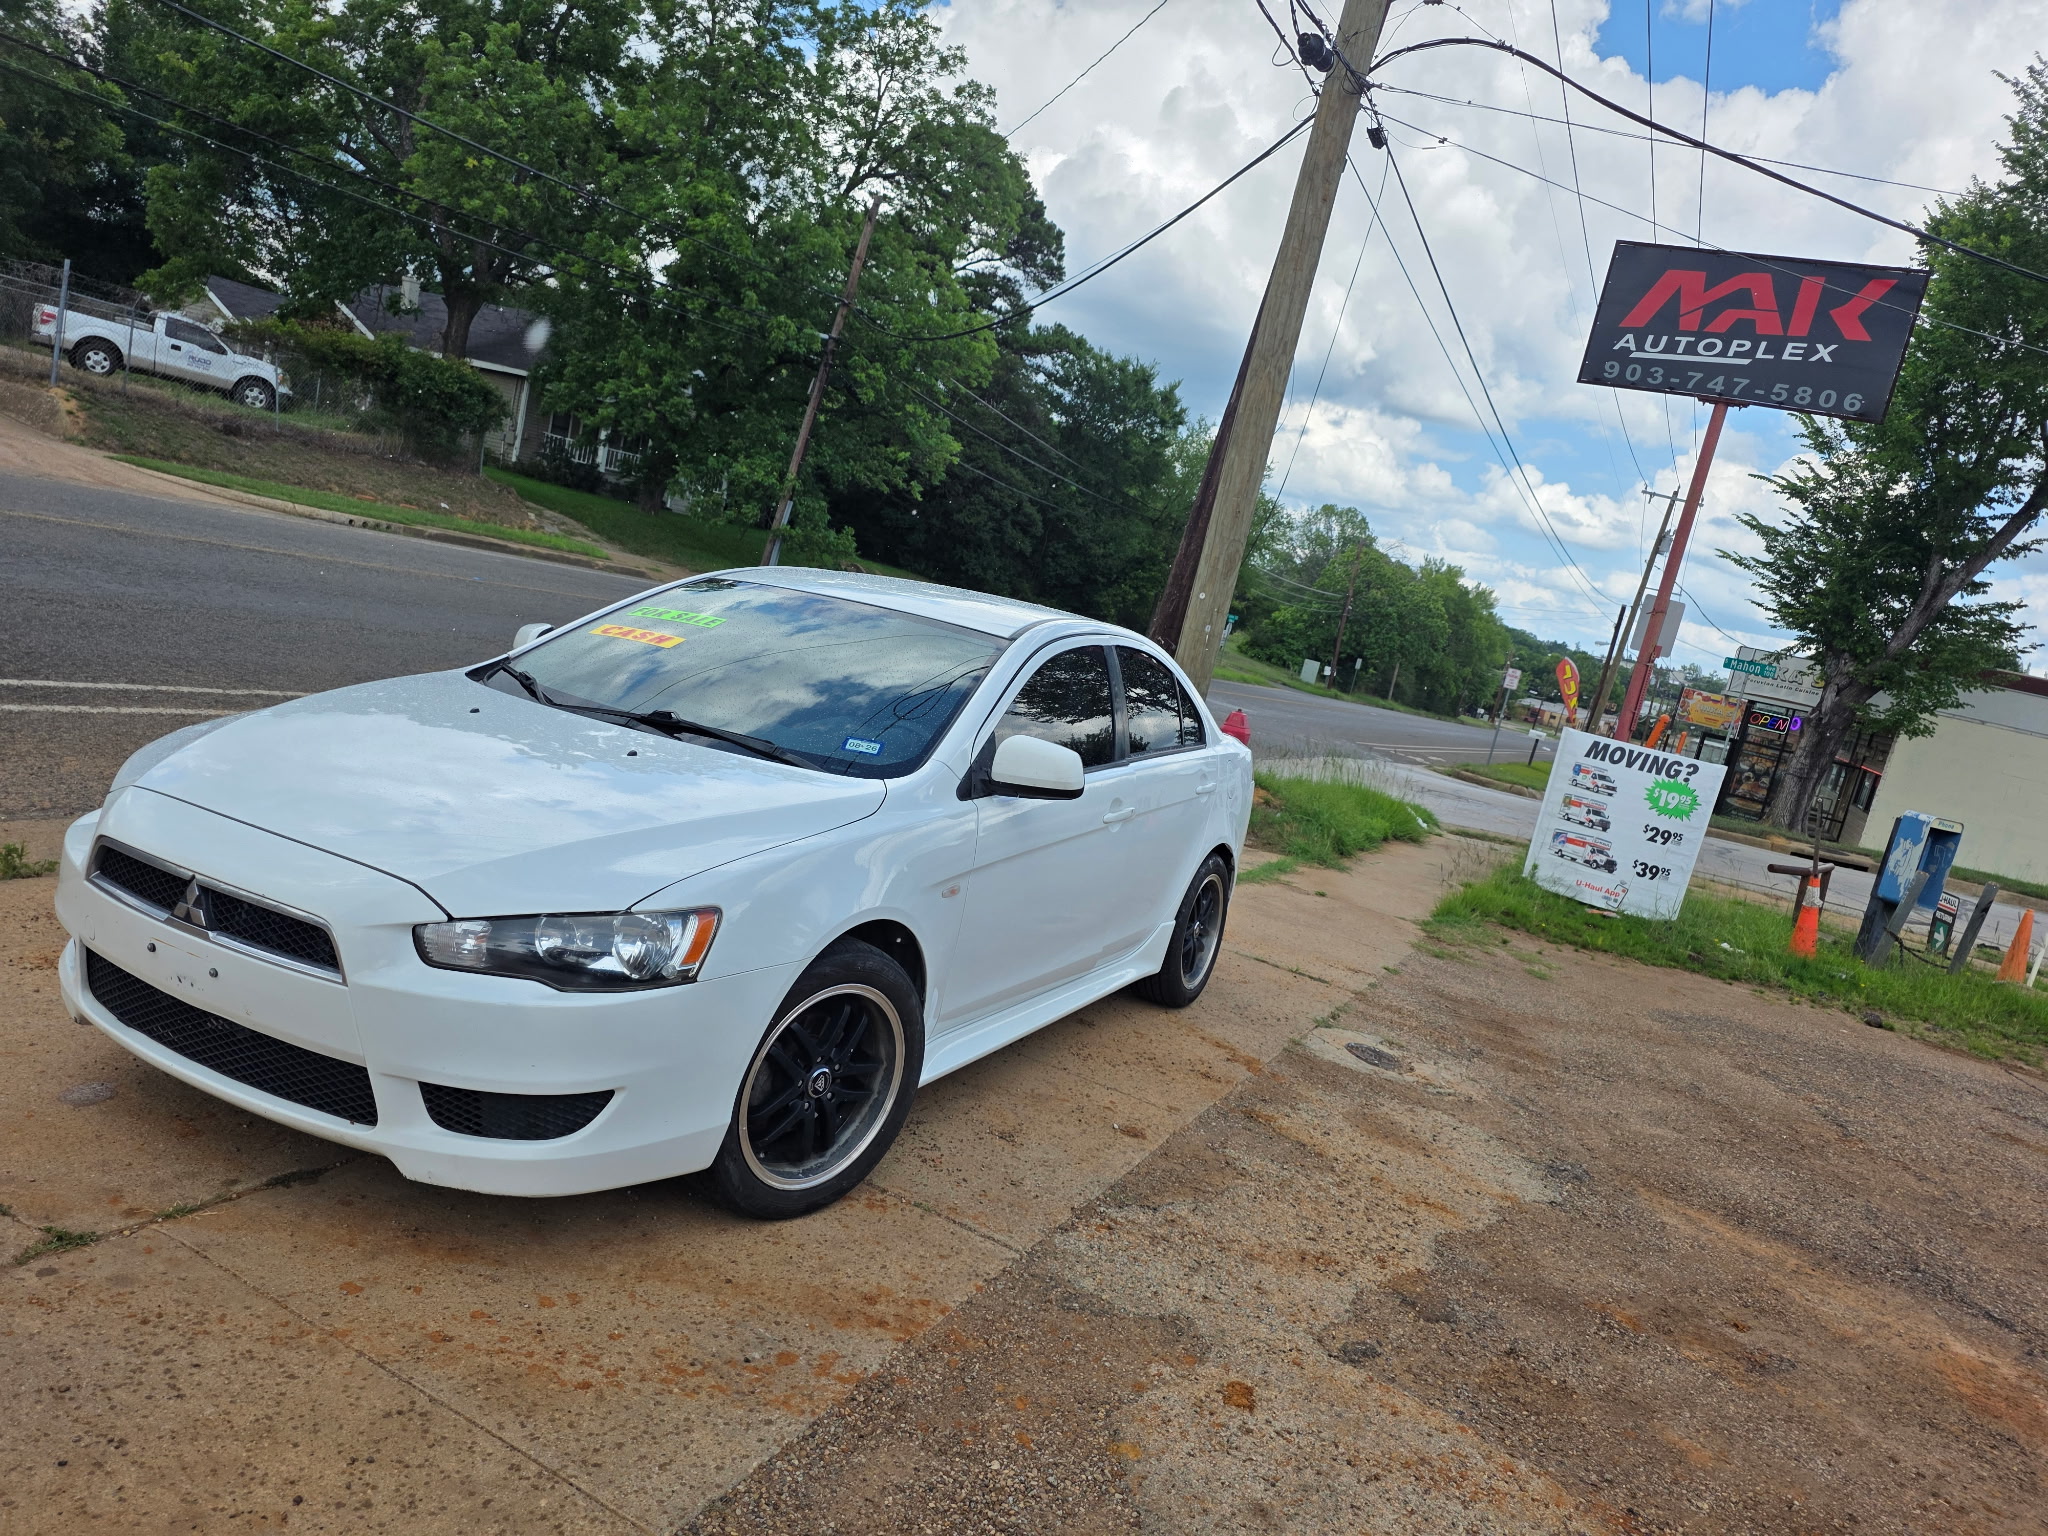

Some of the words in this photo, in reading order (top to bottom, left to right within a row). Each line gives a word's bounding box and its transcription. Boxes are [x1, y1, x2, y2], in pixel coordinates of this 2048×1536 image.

[1618, 269, 1899, 342] MAK
[1613, 333, 1839, 363] AUTOPLEX
[1603, 361, 1864, 412] 903-747-5806
[630, 606, 672, 617] FOR
[670, 612, 720, 626] SALE
[600, 626, 675, 644] CASH
[1730, 658, 1761, 674] Mahon
[1775, 683, 1793, 691] Latin
[1794, 687, 1820, 696] Cuisine
[1750, 713, 1788, 731] OPEN
[1584, 740, 1700, 783] MOVING?
[1576, 879, 1603, 893] U-Haul
[1604, 888, 1620, 898] App
